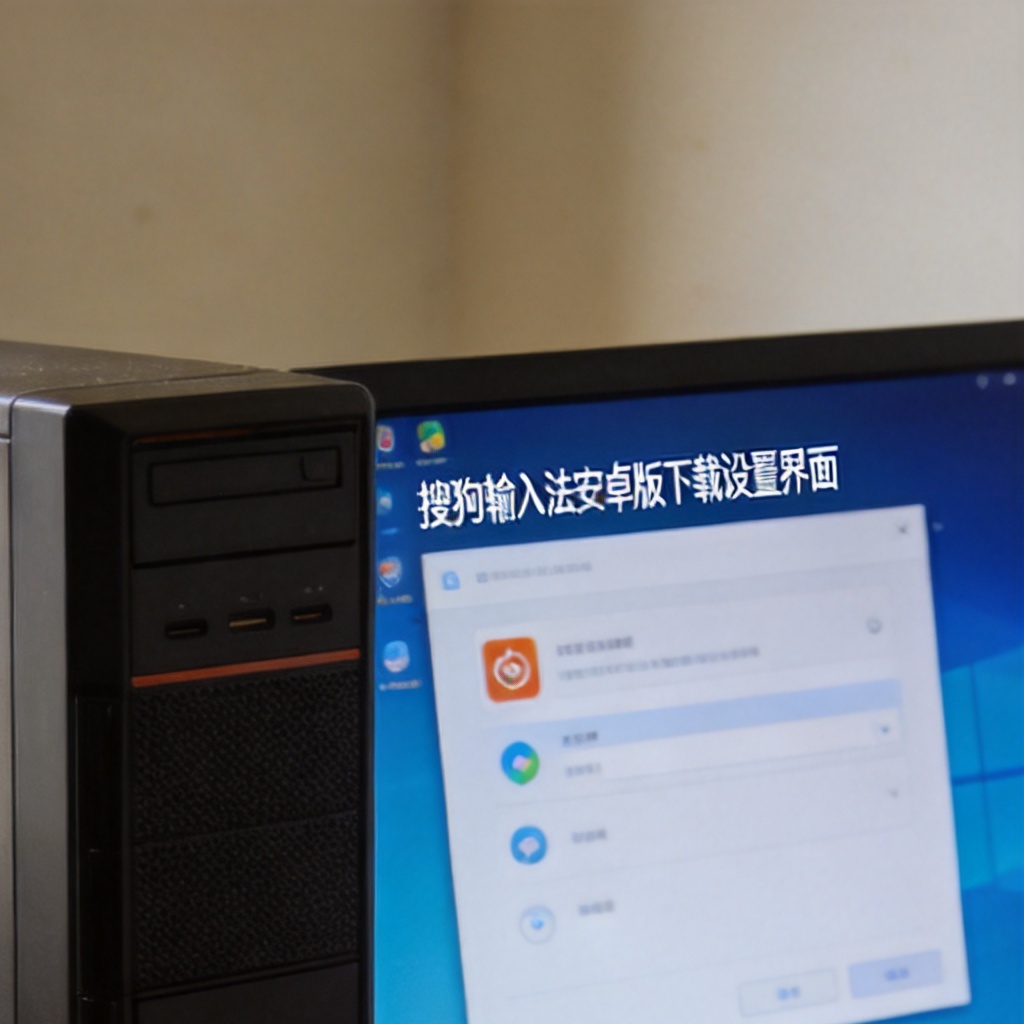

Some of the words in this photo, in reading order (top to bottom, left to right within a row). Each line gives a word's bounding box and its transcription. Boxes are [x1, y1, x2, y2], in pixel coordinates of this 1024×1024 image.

[417, 445, 839, 530] 搜狗输入法安卓版下载设置界面
